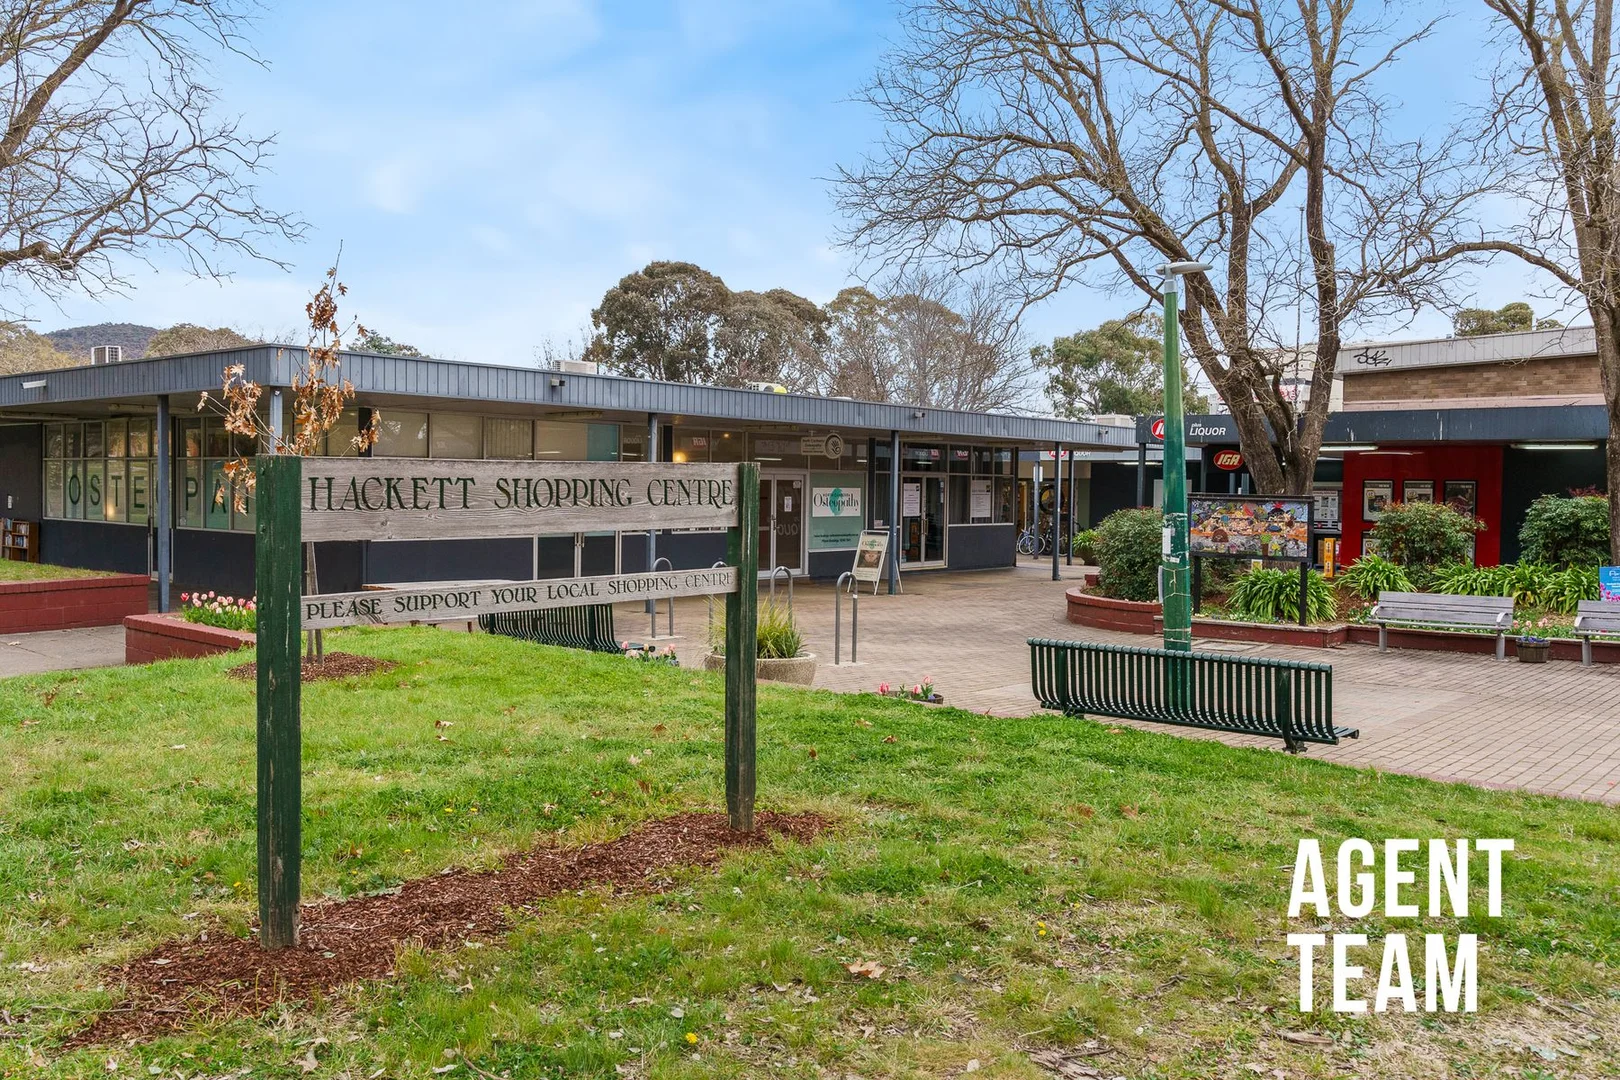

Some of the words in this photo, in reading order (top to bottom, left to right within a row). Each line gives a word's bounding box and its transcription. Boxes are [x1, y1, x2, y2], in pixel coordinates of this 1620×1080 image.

[1189, 427, 1226, 436] LIQUOR
[1217, 454, 1241, 465] IGA
[308, 476, 476, 511] HACKETT
[494, 477, 633, 509] SHOPPING
[647, 478, 735, 508] CENTRE
[813, 492, 859, 512] Osteopathy
[306, 597, 382, 620] PLEASE
[394, 591, 482, 613] SUPPORT
[490, 586, 538, 605] YOUR
[547, 581, 601, 601] LOCAL
[608, 575, 678, 596] SHOPPING
[685, 571, 734, 588] CENTRE
